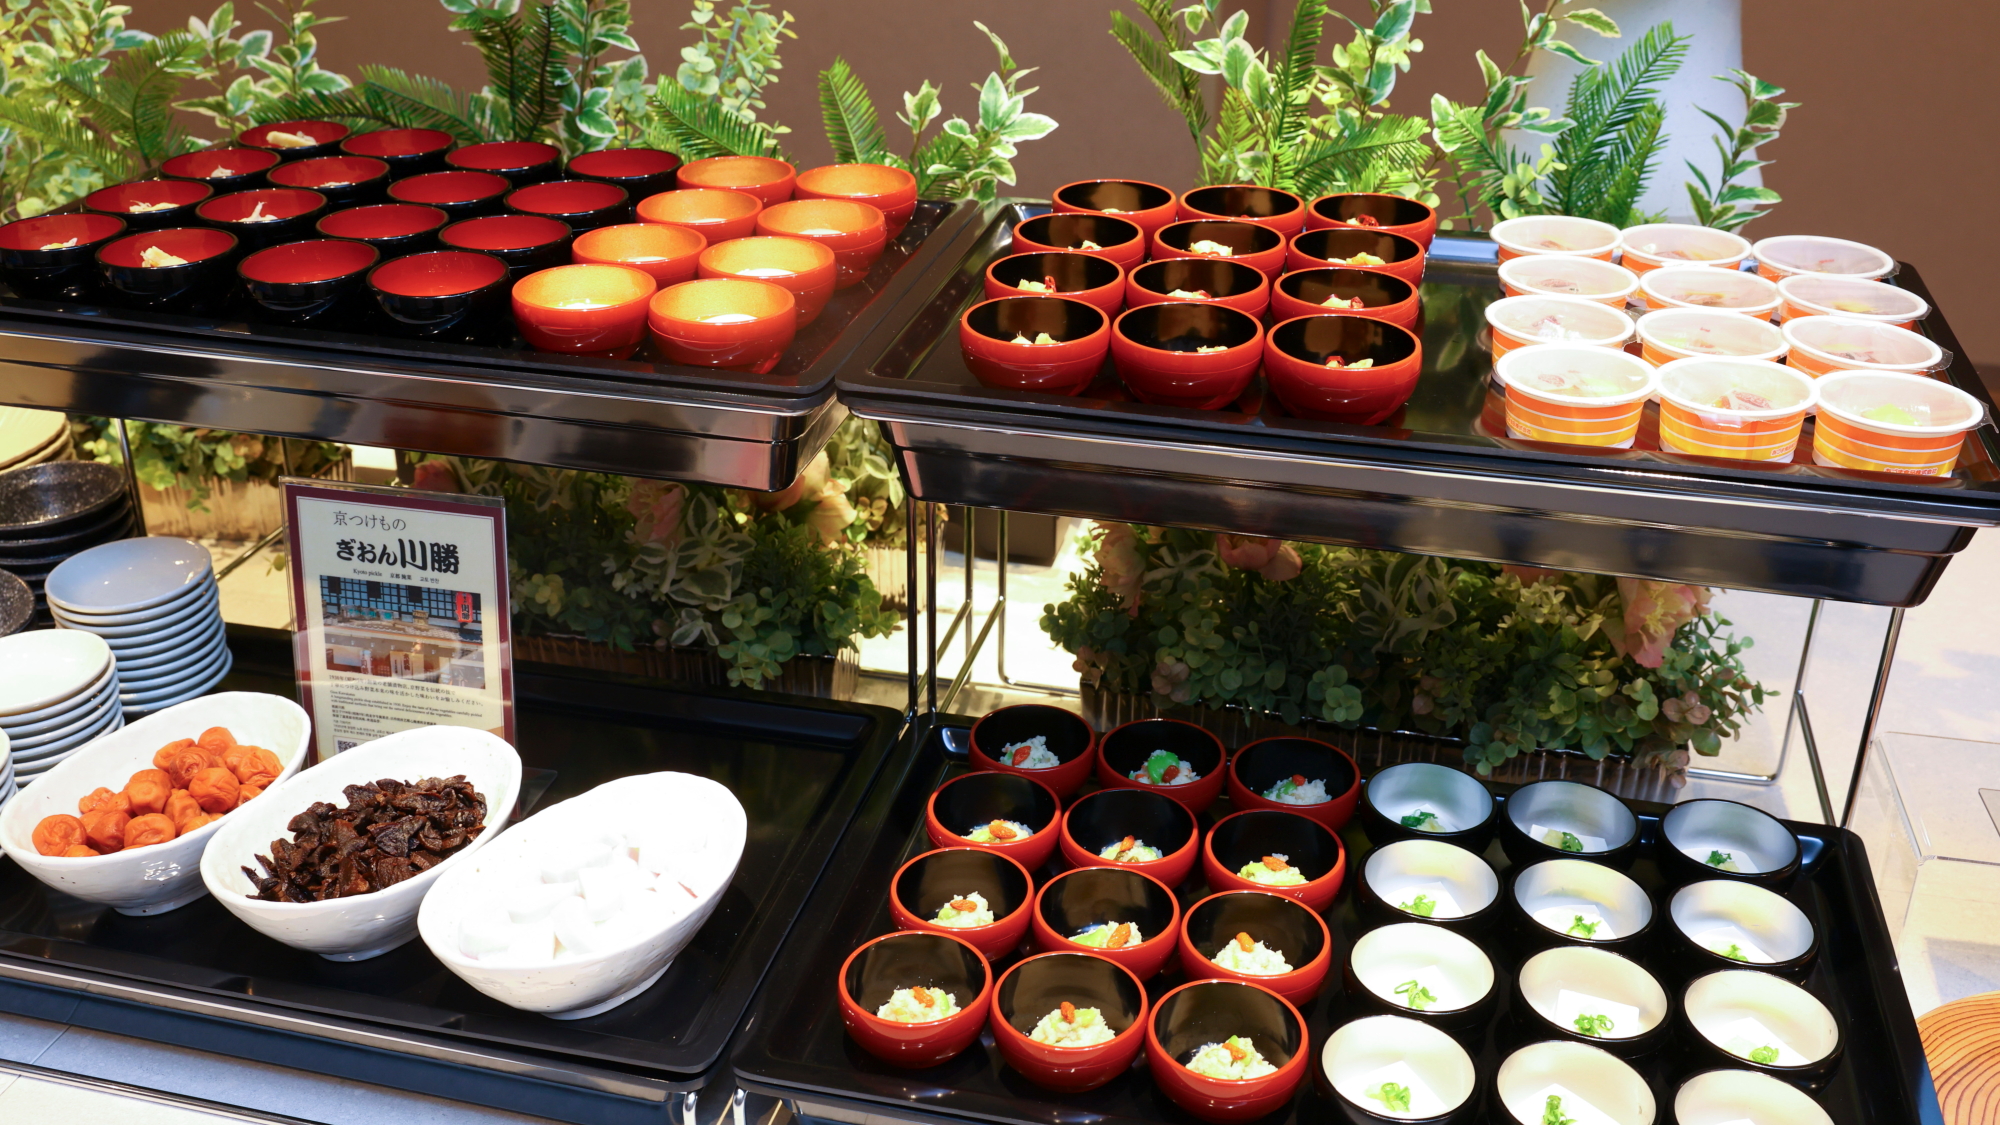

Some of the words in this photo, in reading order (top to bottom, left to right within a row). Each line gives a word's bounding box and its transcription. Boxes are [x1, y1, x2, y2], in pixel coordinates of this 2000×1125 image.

[333, 511, 406, 531] 京つけもの
[336, 538, 459, 574] ぎおん川勝
[353, 568, 368, 576] Kyoto
